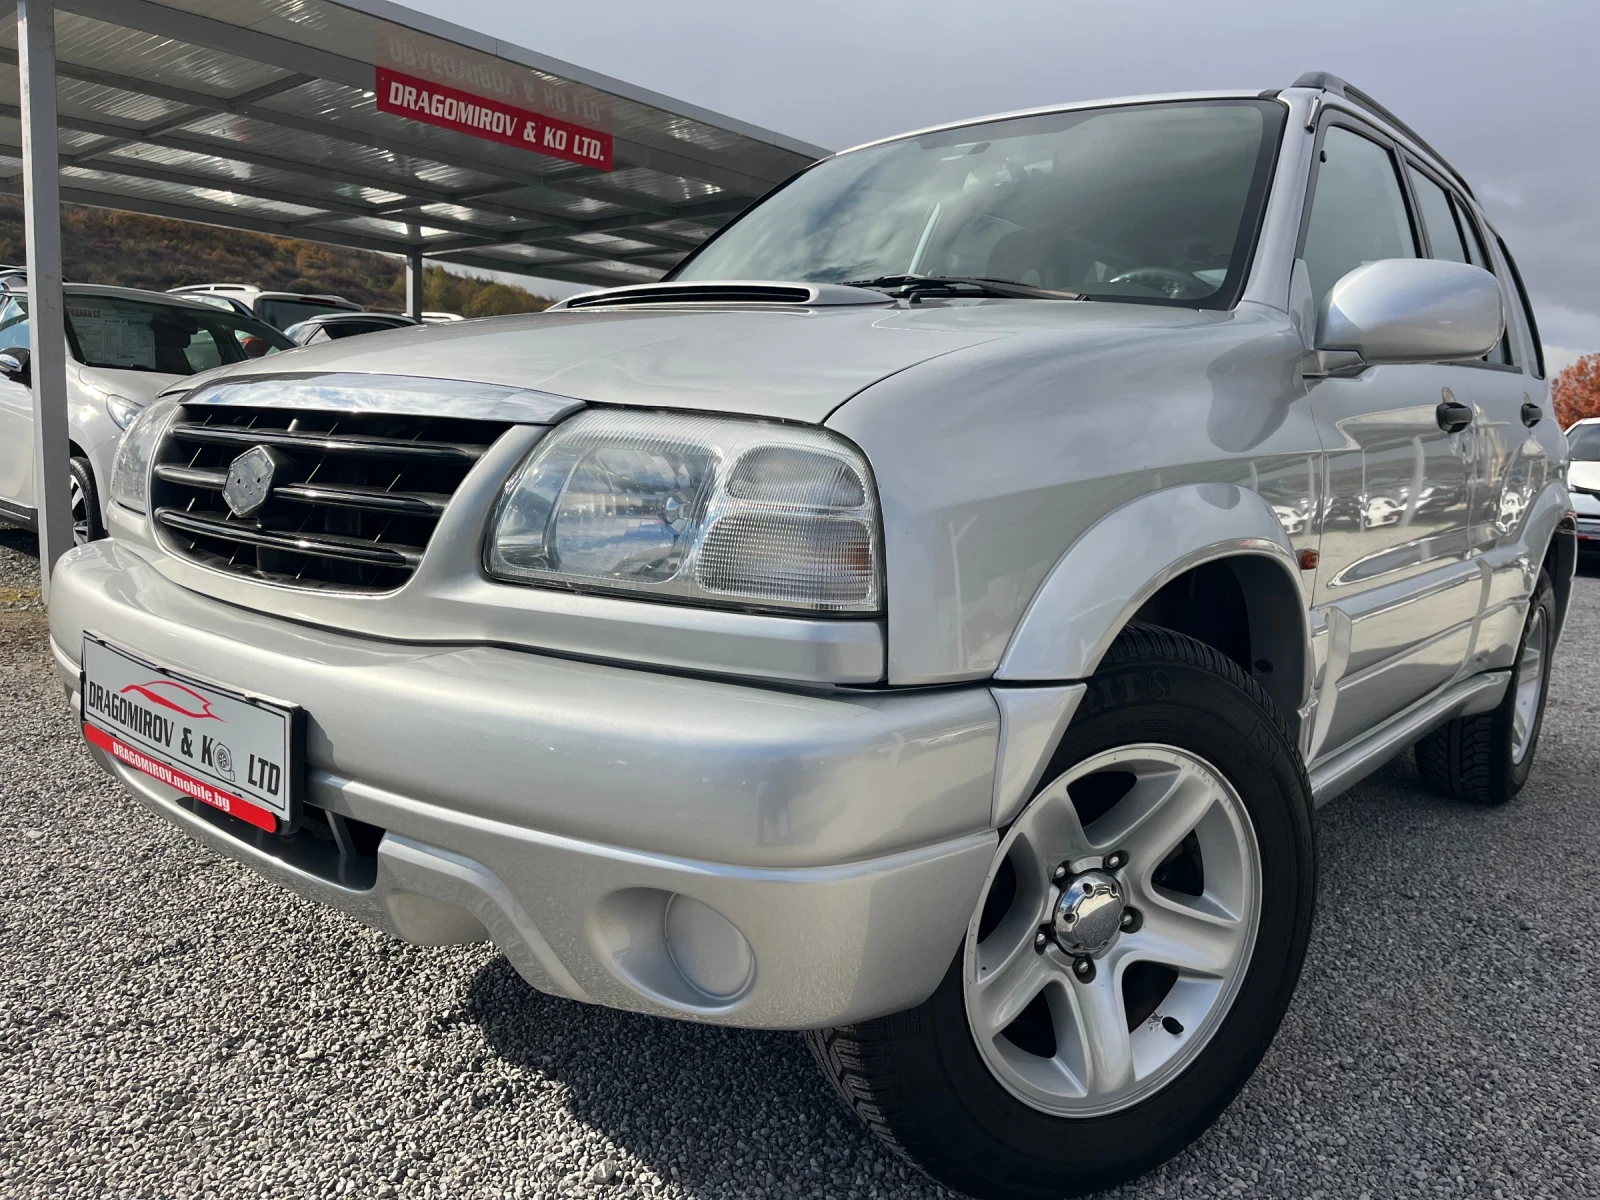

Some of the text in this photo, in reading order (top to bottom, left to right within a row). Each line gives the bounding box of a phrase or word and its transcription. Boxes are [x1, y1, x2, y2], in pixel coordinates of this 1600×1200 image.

[389, 81, 604, 161] DRAGOMIROV & KO LTD.
[67, 308, 92, 318] РОДАВА
[89, 681, 174, 748] DRAGOMIROV
[181, 726, 194, 758] &
[248, 754, 281, 796] LTD
[112, 741, 231, 812] DRAGOMIROV.mobile.bg
